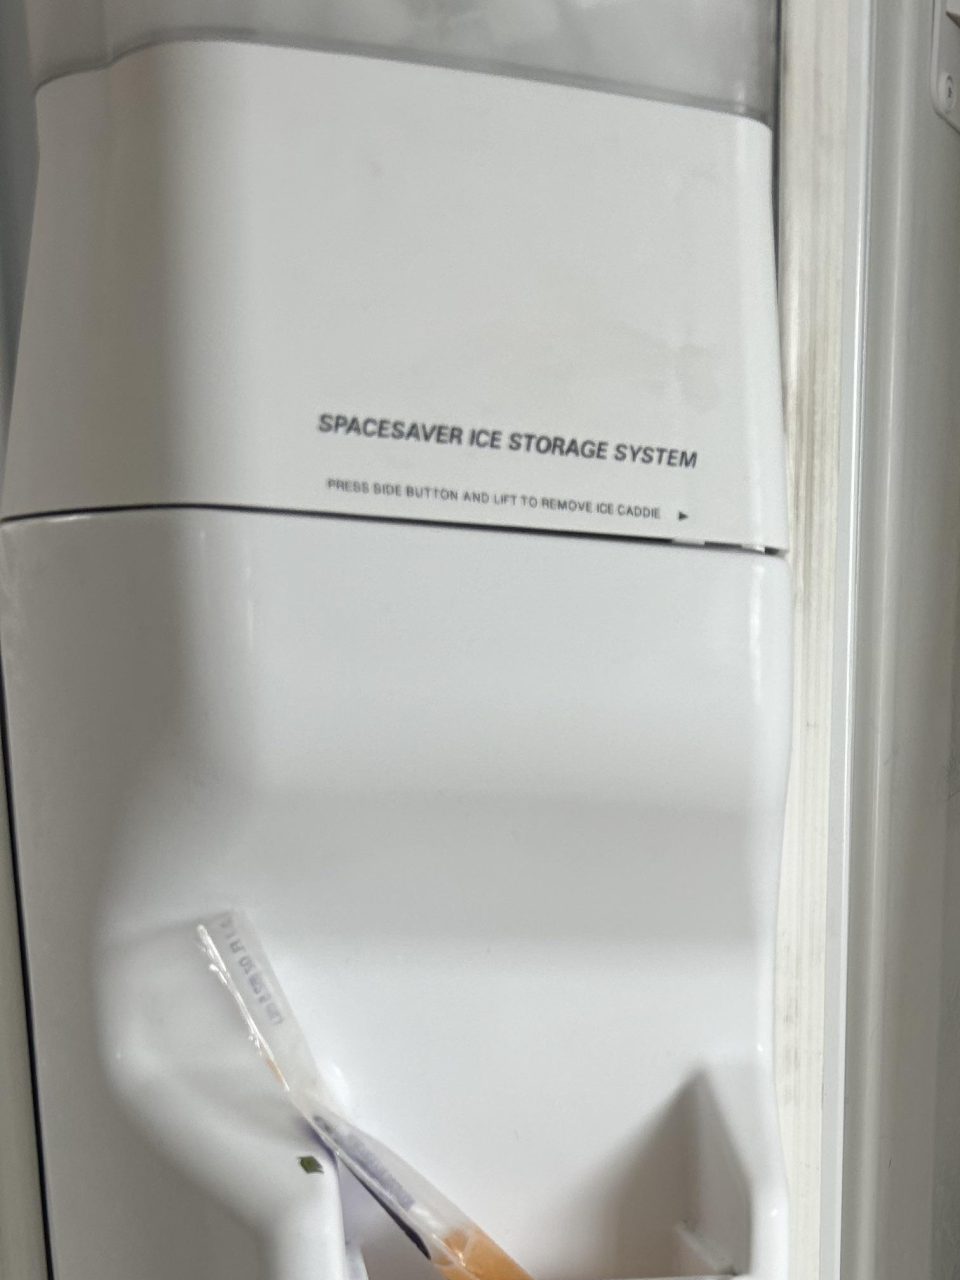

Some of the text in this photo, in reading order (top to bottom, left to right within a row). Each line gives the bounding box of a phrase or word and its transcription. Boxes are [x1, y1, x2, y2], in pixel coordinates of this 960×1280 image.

[317, 413, 698, 469] SPACESAVER ICE STORAGE SYSTEM
[326, 478, 661, 520] PRESS SIDE BUTTON AND LIFT TO REMOVE ICE CADDIE
